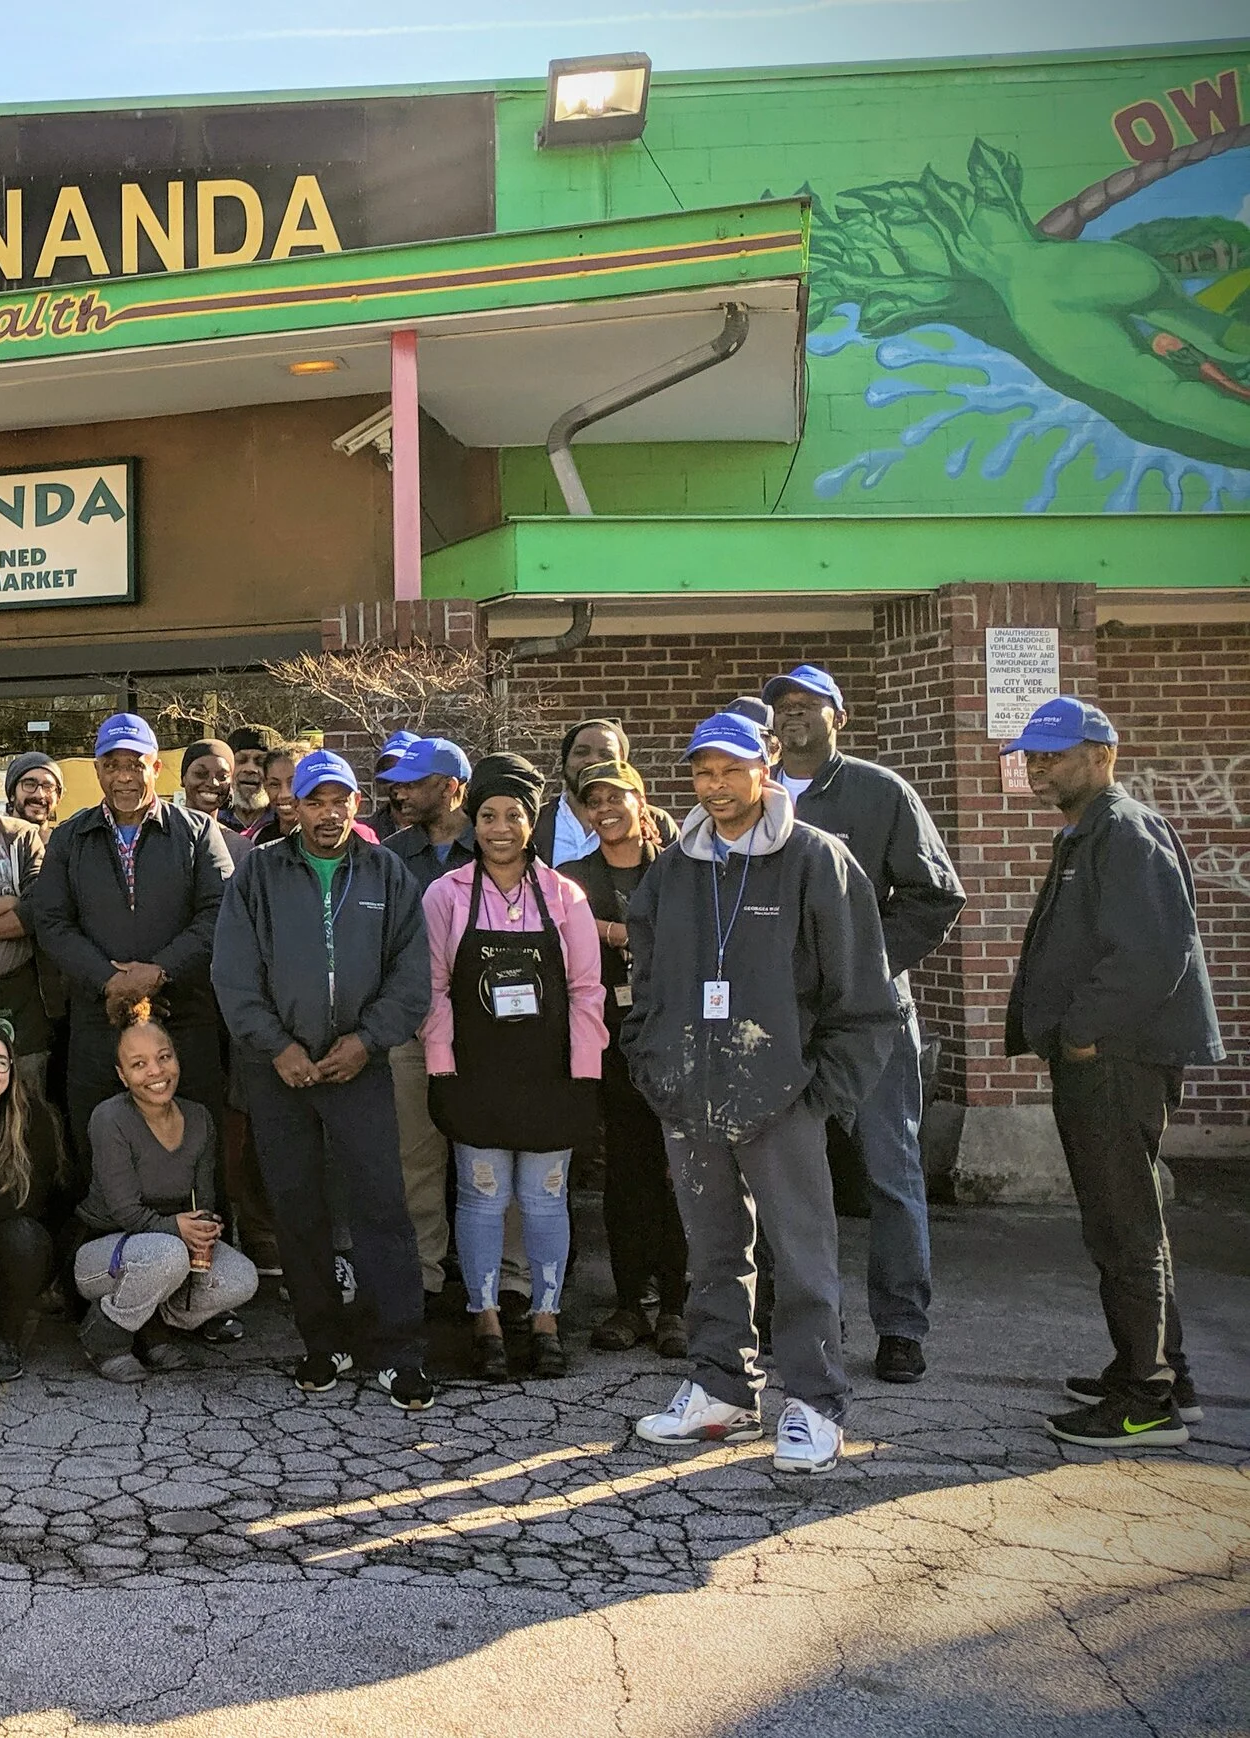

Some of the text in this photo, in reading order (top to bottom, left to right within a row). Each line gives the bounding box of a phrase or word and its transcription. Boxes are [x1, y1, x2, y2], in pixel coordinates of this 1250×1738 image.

[1007, 636, 1051, 644] ABANDONED
[991, 651, 1017, 659] TOWED
[989, 666, 1056, 674] OWNERS EXPENSE
[1003, 678, 1043, 686] CITY WIDE
[989, 686, 1058, 694] WRECKER SERVICE
[1008, 779, 1031, 788] BUIL
